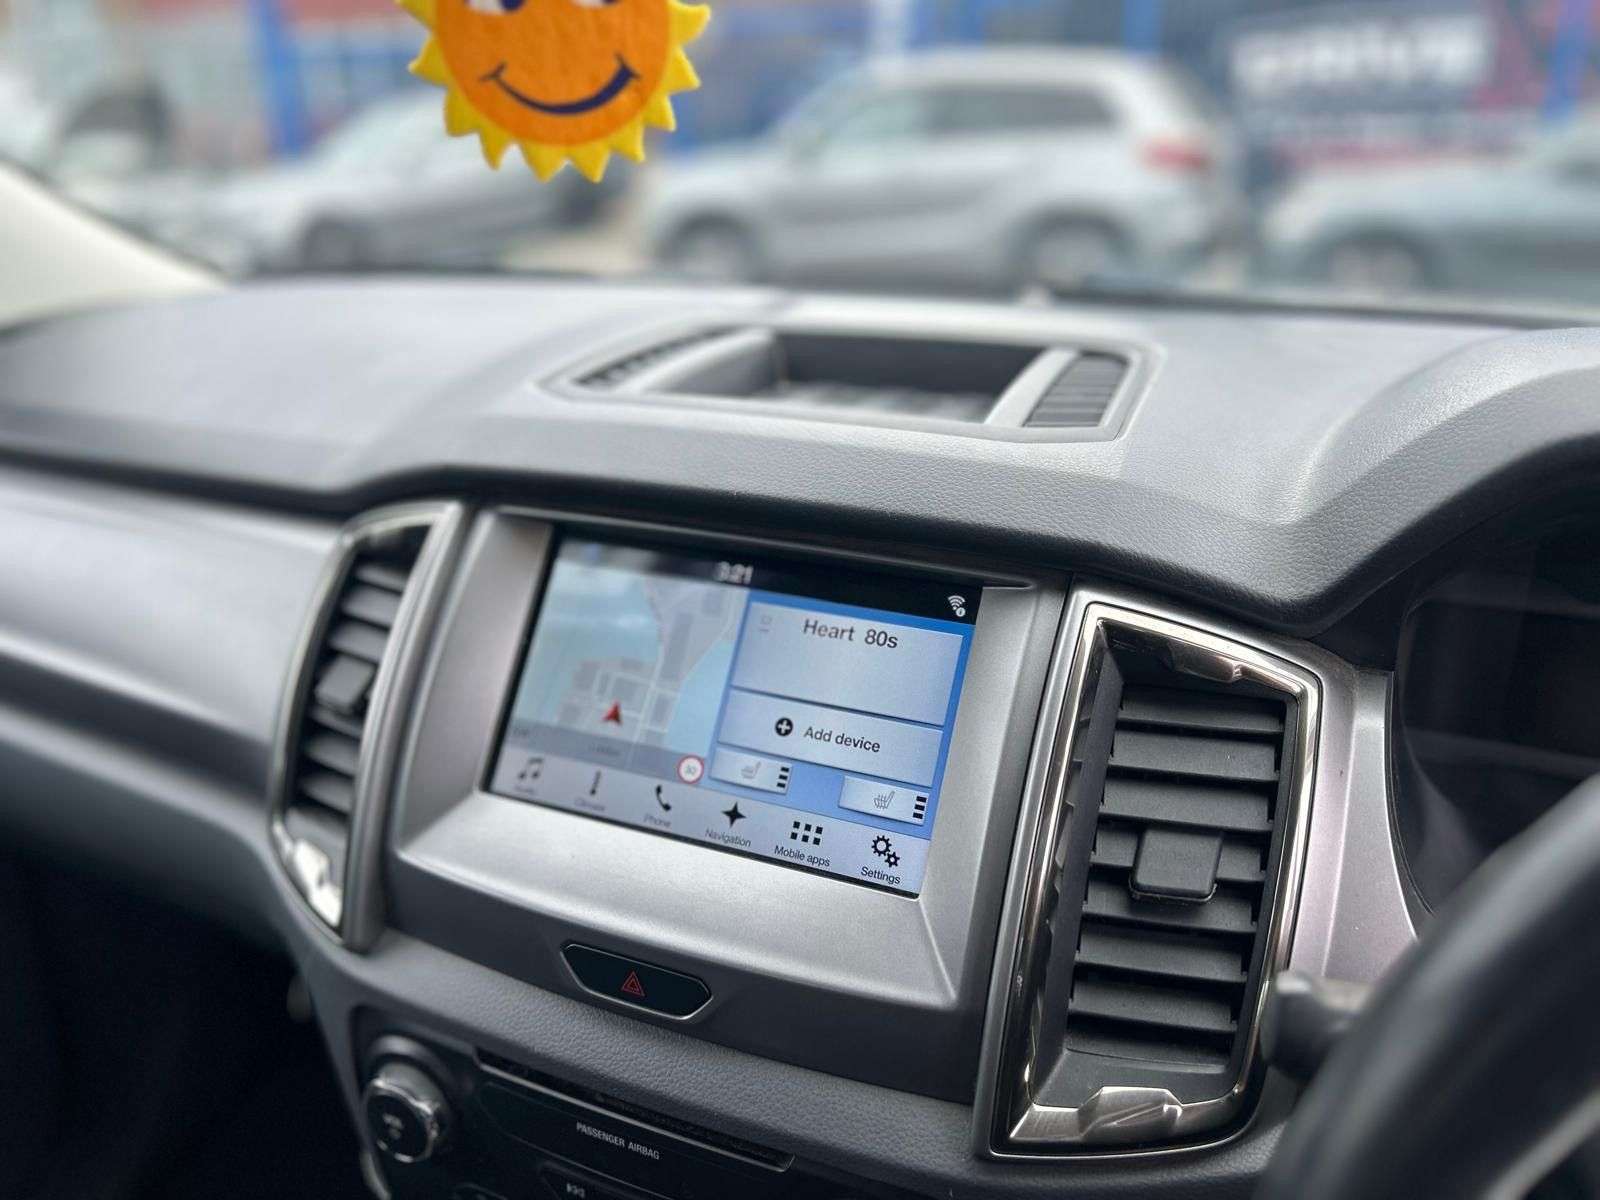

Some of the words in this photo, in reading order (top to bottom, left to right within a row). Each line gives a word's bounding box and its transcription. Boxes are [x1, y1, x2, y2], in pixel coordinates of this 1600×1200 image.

[803, 618, 855, 642] Heart
[864, 628, 899, 649] 80s
[803, 726, 833, 743] Add
[835, 732, 881, 753] device
[705, 828, 751, 848] Navigation
[774, 845, 806, 862] Mobile
[806, 854, 831, 868] apps
[860, 866, 901, 885] Settings
[576, 1121, 625, 1148] PASSENGER
[627, 1141, 660, 1160] AIRBAG
